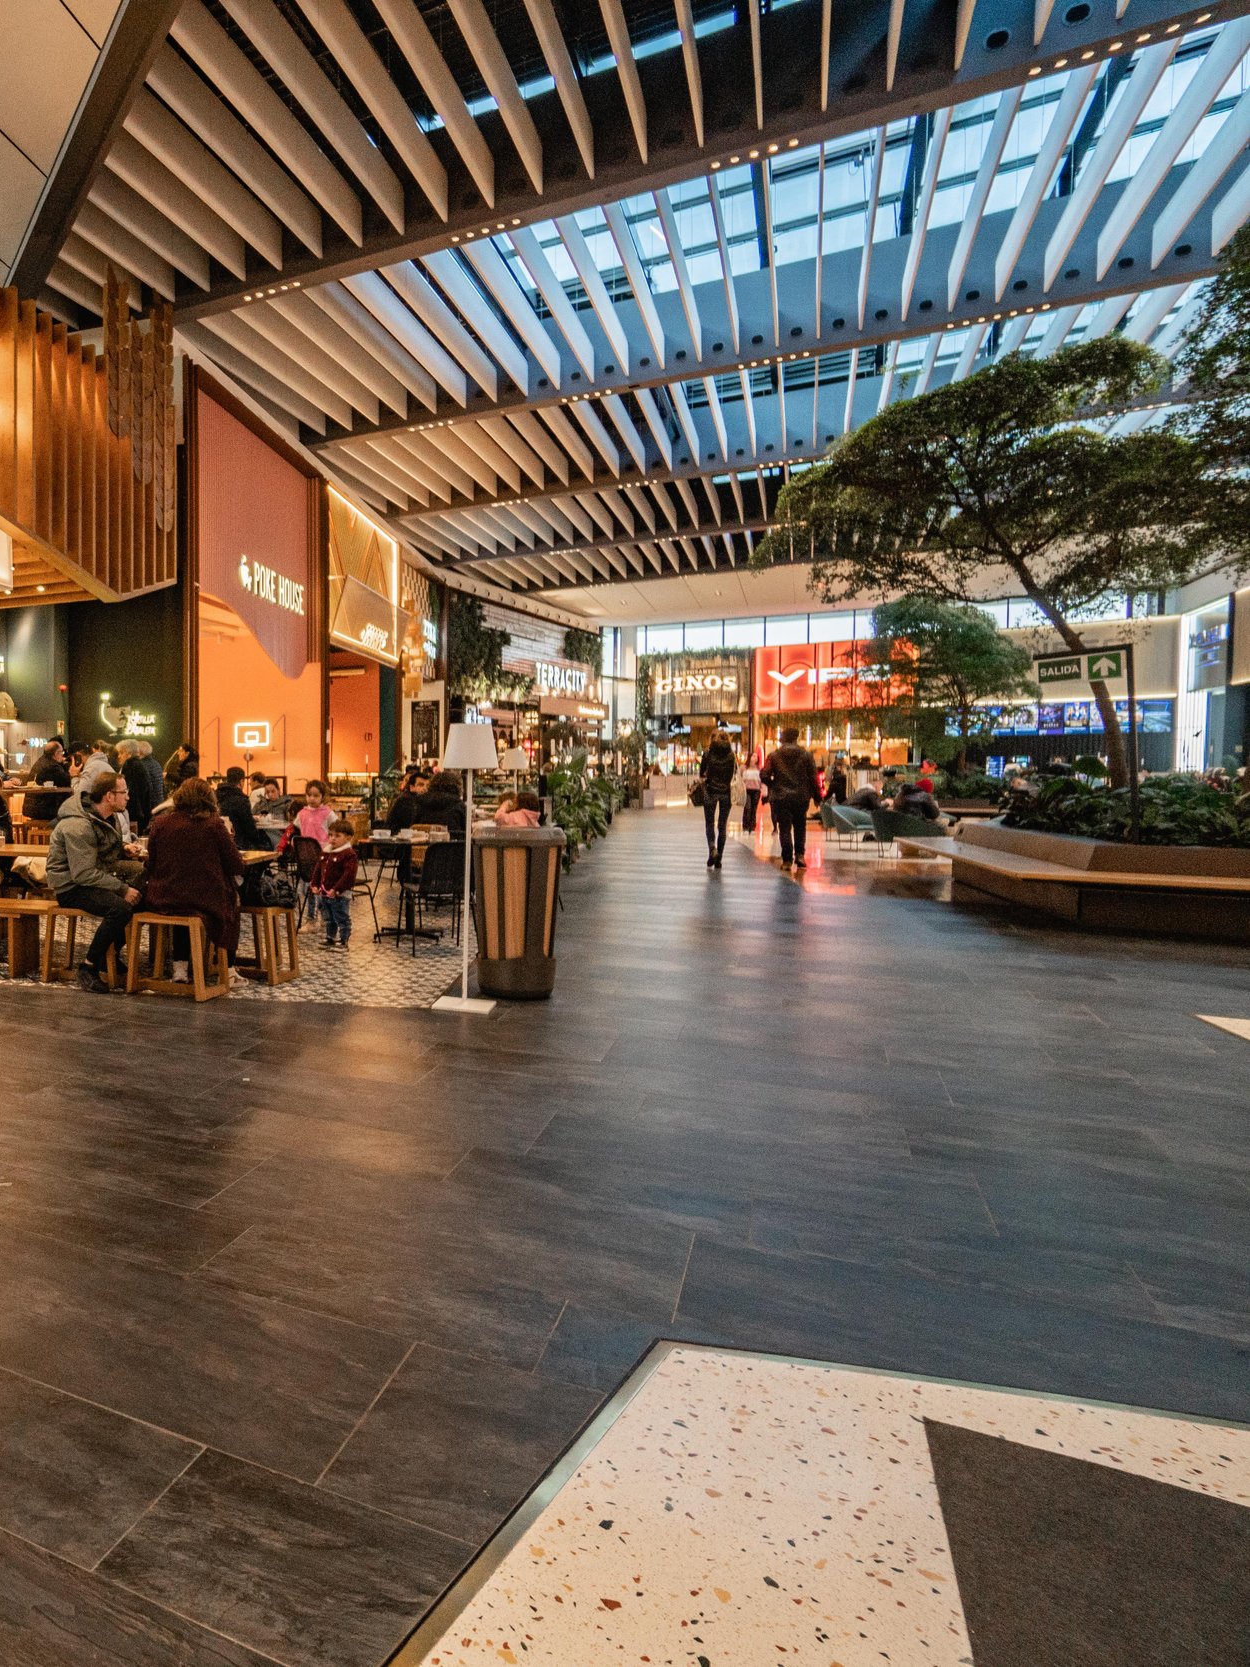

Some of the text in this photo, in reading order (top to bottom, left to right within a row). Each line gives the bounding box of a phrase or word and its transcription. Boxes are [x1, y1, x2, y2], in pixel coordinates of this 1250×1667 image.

[253, 561, 305, 616] POKE HOUSE
[536, 661, 586, 692] TERRACITY
[1039, 664, 1080, 677] SALIDA
[655, 674, 737, 695] GINOS
